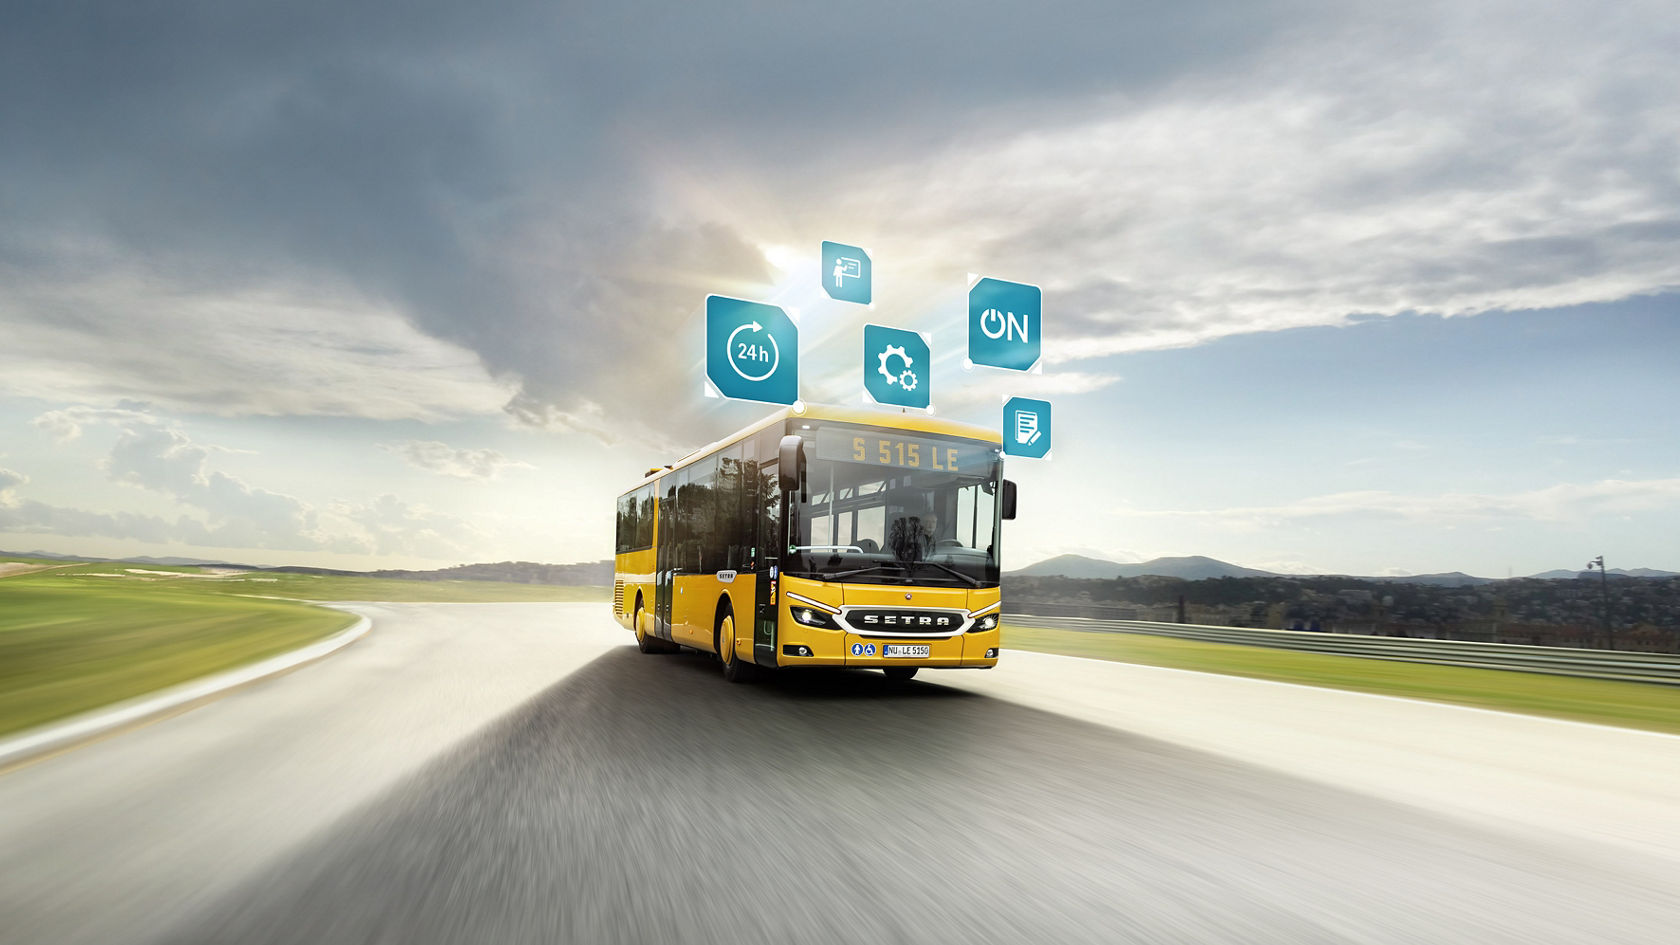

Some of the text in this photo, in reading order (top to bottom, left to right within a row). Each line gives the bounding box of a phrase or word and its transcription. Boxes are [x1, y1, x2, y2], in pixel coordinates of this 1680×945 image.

[853, 437, 959, 471] S 515 LE
[864, 615, 950, 626] SETRA
[902, 646, 911, 655] LE
